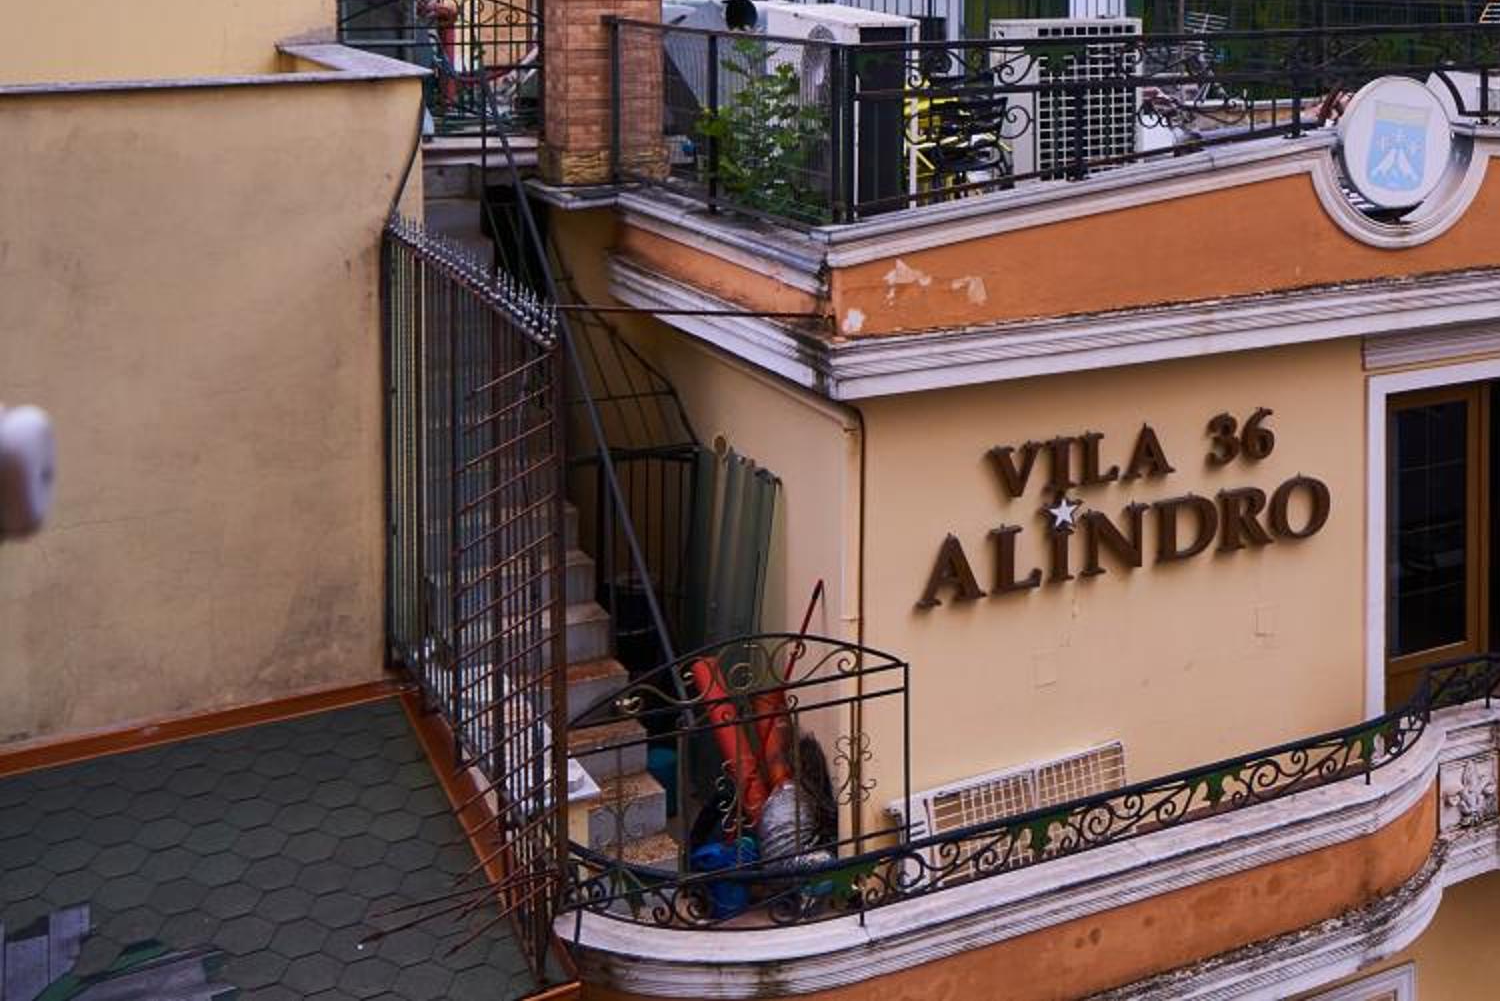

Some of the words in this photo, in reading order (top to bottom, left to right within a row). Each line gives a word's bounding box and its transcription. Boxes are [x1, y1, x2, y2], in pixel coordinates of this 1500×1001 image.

[986, 421, 1175, 498] VILA
[1205, 406, 1275, 466] 36
[914, 472, 1331, 610] ALINDRO
